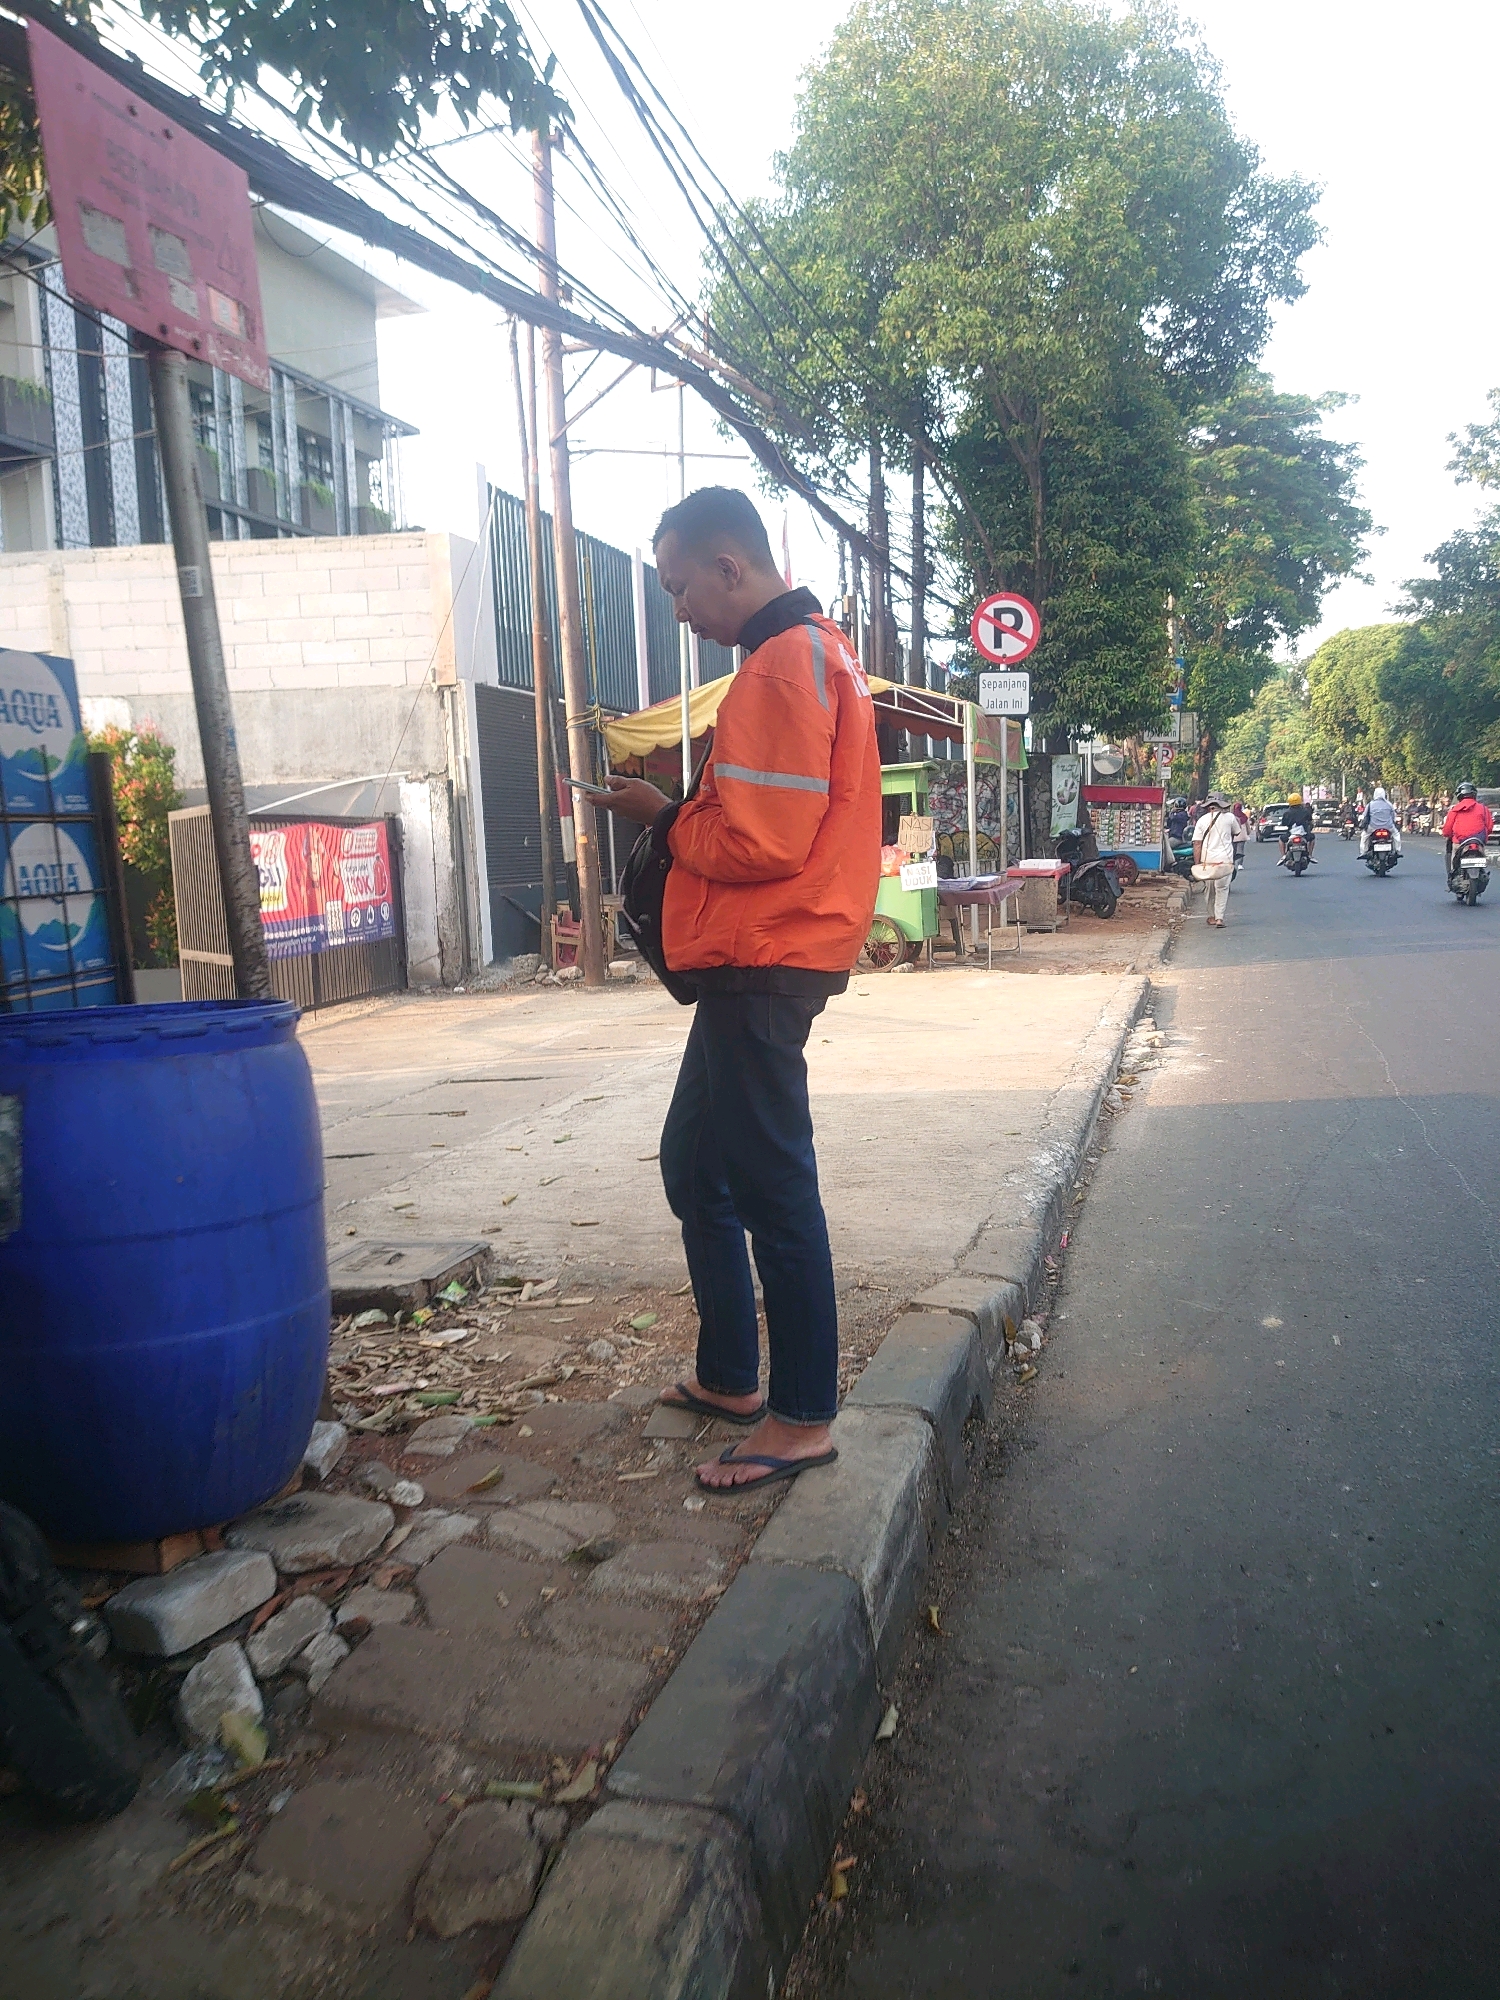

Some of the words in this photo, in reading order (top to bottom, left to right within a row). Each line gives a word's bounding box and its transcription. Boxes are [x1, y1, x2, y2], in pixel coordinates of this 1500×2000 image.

[993, 607, 1024, 649] P
[982, 679, 1027, 691] Sepanjang
[986, 698, 1008, 709] Jalan
[1012, 698, 1023, 709] Ini
[901, 818, 932, 831] NASI
[900, 833, 931, 848] UDUK
[906, 866, 931, 876] NASI
[905, 876, 933, 887] UDUK
